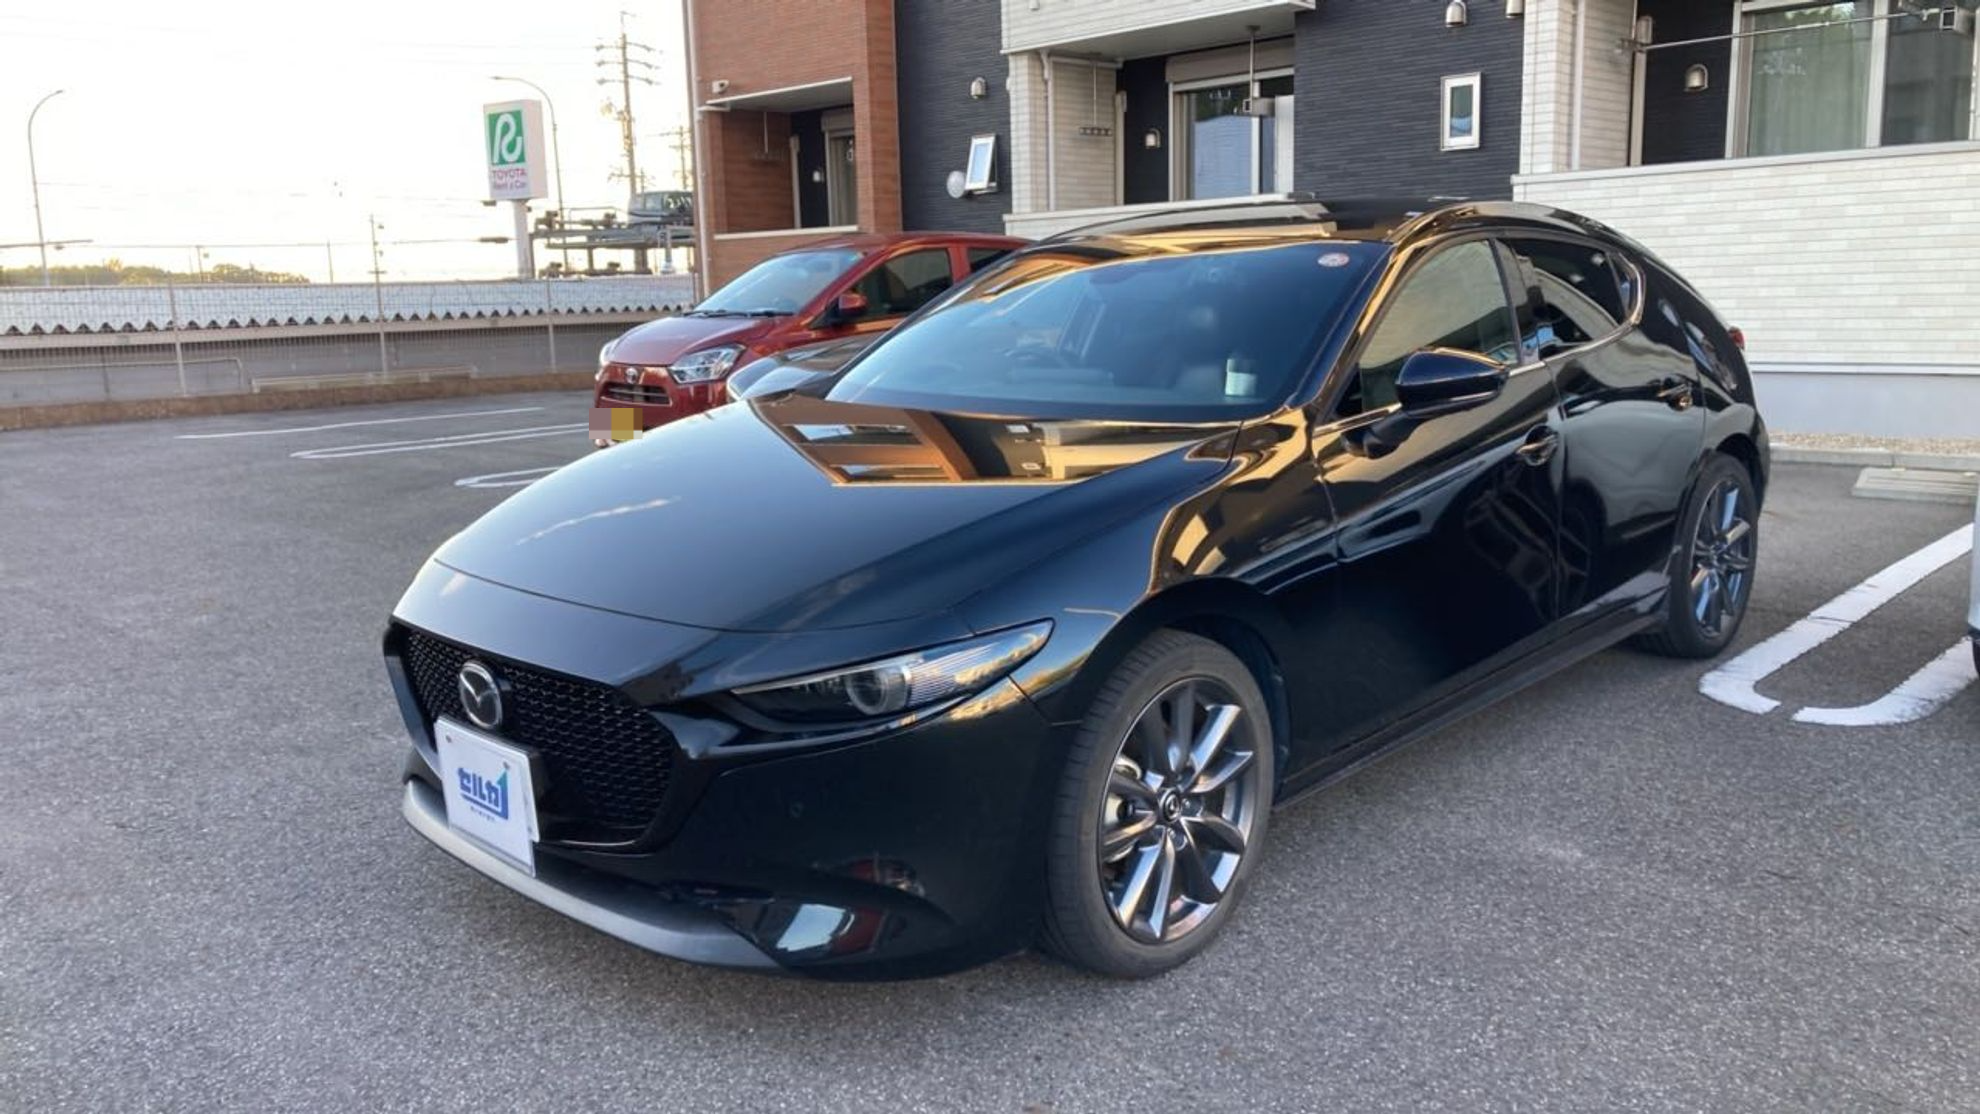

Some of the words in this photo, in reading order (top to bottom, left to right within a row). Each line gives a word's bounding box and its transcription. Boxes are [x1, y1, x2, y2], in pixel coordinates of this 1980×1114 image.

[492, 168, 527, 180] TOYOTA
[458, 768, 500, 808] セルカ
